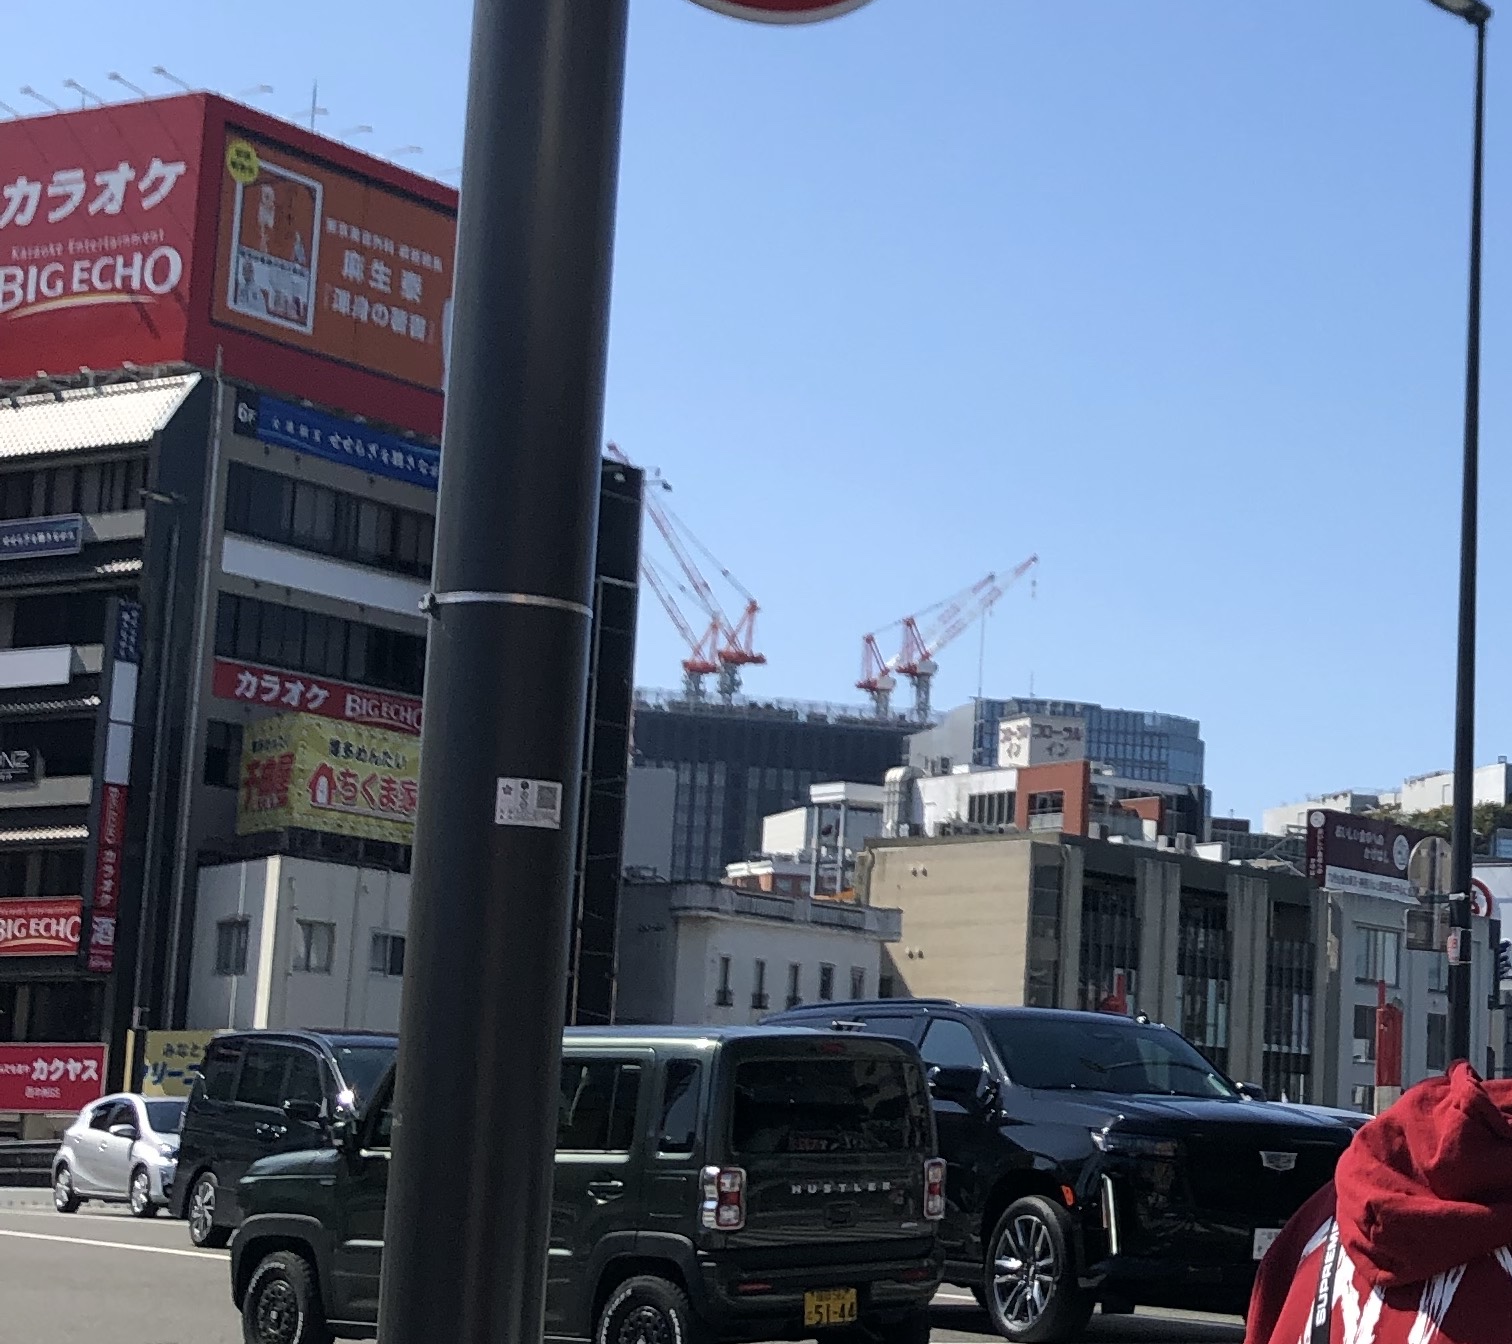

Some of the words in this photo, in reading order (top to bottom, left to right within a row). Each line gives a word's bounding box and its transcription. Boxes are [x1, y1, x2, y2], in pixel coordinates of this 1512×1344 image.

[0, 157, 187, 229] カラオケ
[0, 261, 65, 313] BIG
[72, 245, 183, 294] ECHO
[234, 669, 330, 709] カラオケ
[345, 692, 381, 720] BIG
[29, 915, 82, 943] ECHO
[32, 1057, 99, 1082] カクヤス
[791, 1181, 891, 1194] HUSTLER
